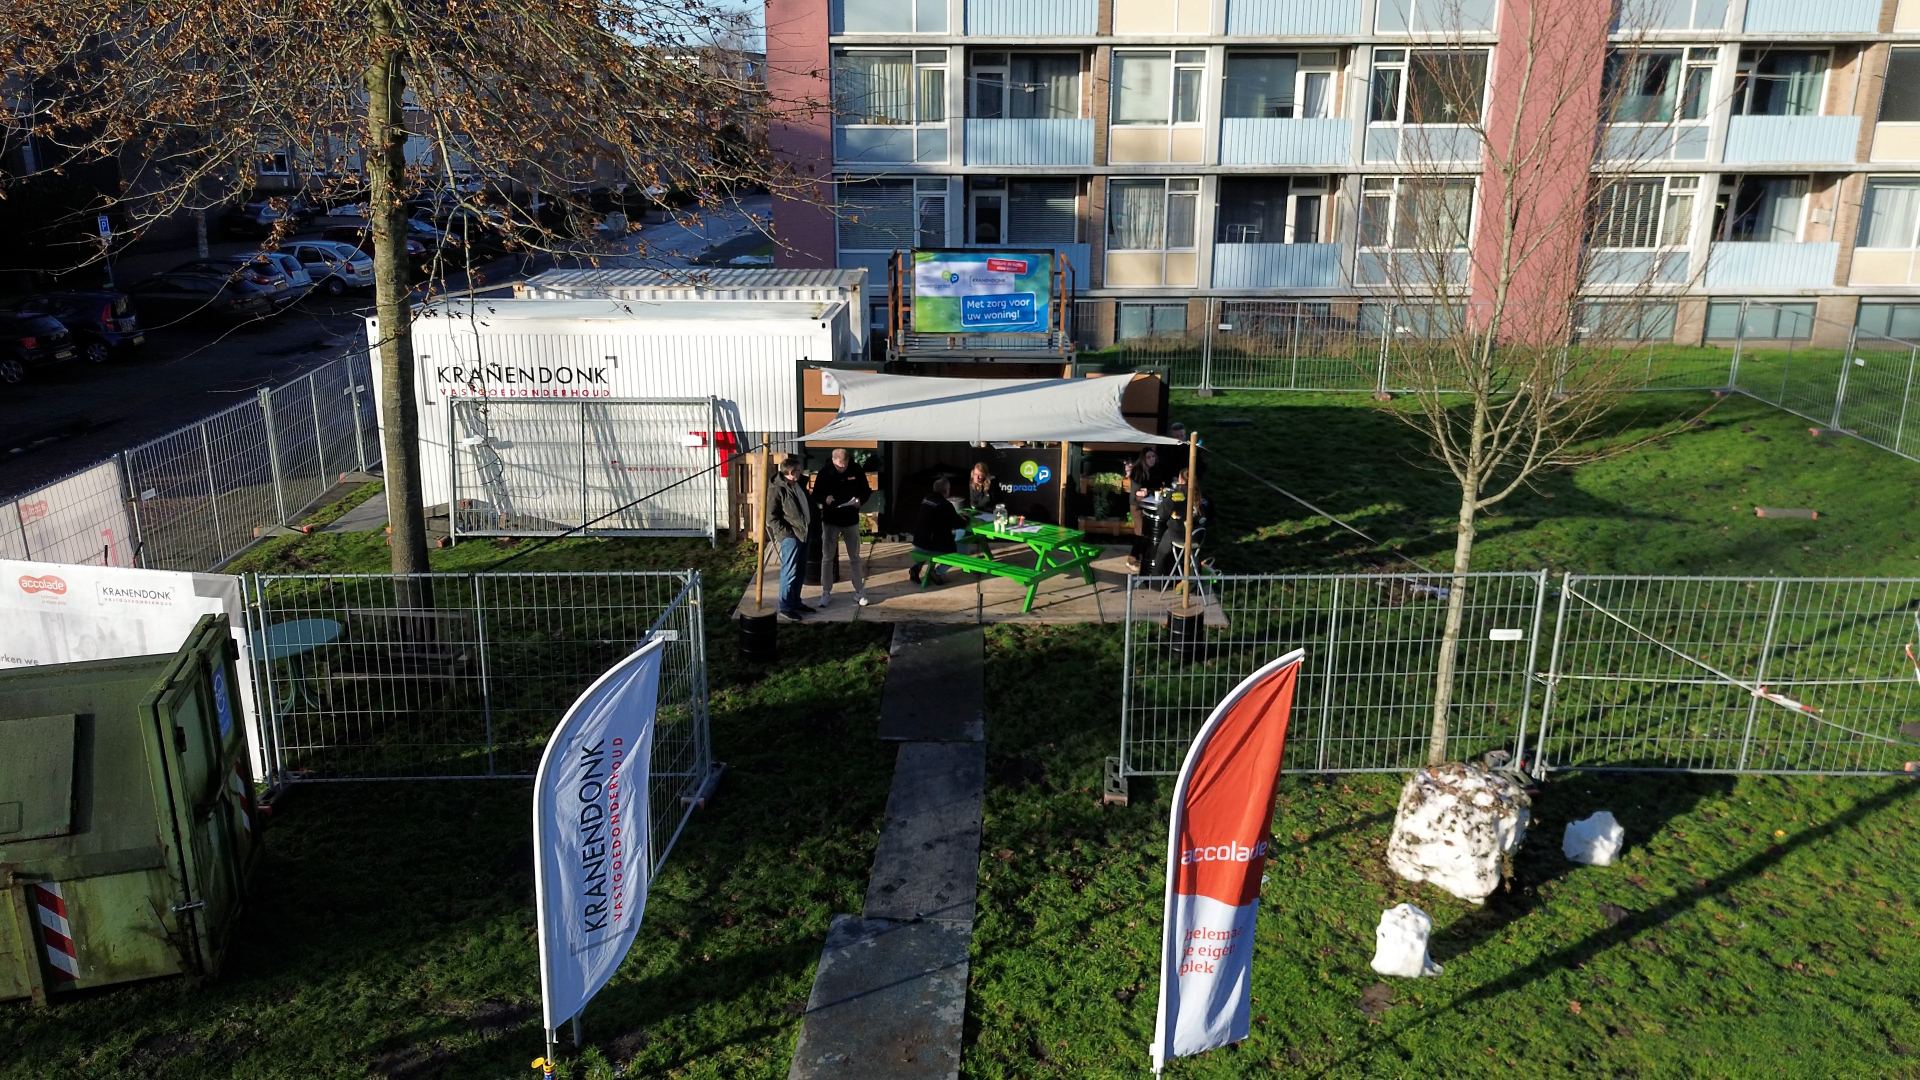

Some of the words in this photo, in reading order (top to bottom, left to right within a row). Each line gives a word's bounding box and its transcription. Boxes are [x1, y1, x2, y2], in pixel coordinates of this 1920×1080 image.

[966, 300, 985, 309] Met
[987, 300, 1007, 309] zorg
[1009, 299, 1030, 307] voor
[983, 310, 1020, 320] woning!
[437, 366, 608, 384] KRANENDONK
[440, 388, 610, 397] VASTGOEDONDERHOUD
[21, 578, 65, 591] accolade
[102, 587, 172, 600] KRANENDONK
[578, 738, 607, 933] KRANENDONK
[609, 737, 623, 921] VASTGOEDONDERHOUD
[1181, 840, 1268, 865] accolade
[1180, 961, 1215, 976] plek
